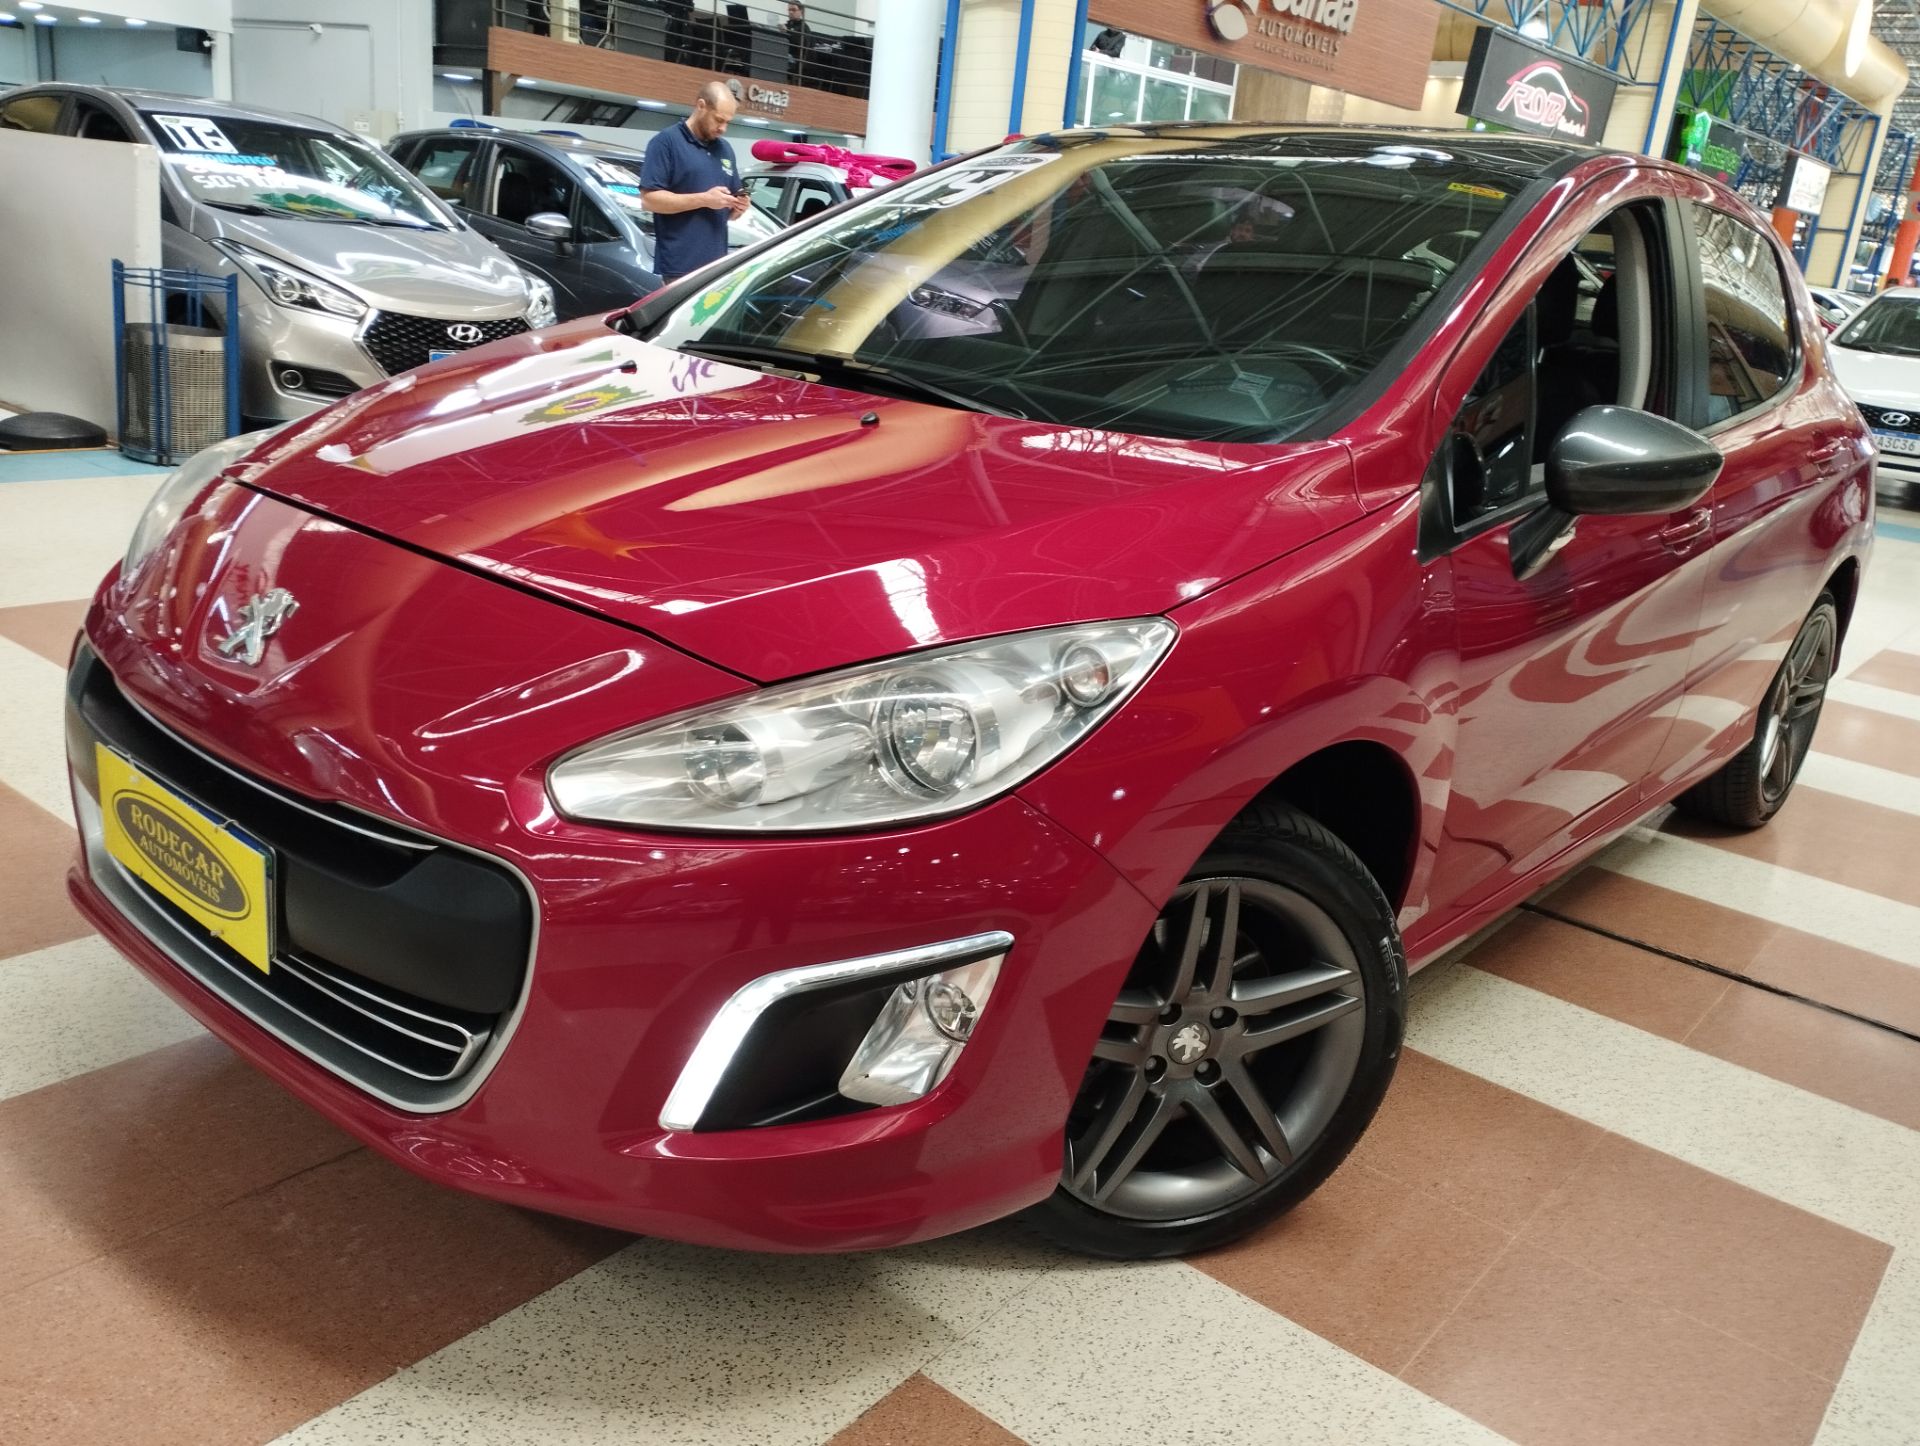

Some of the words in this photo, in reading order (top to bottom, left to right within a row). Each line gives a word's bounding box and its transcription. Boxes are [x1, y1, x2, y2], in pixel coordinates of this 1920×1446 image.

[1258, 18, 1341, 56] AUTOMÓVEIS
[748, 84, 790, 107] Canaã
[166, 124, 229, 150] 16
[130, 804, 225, 890] RODECAR
